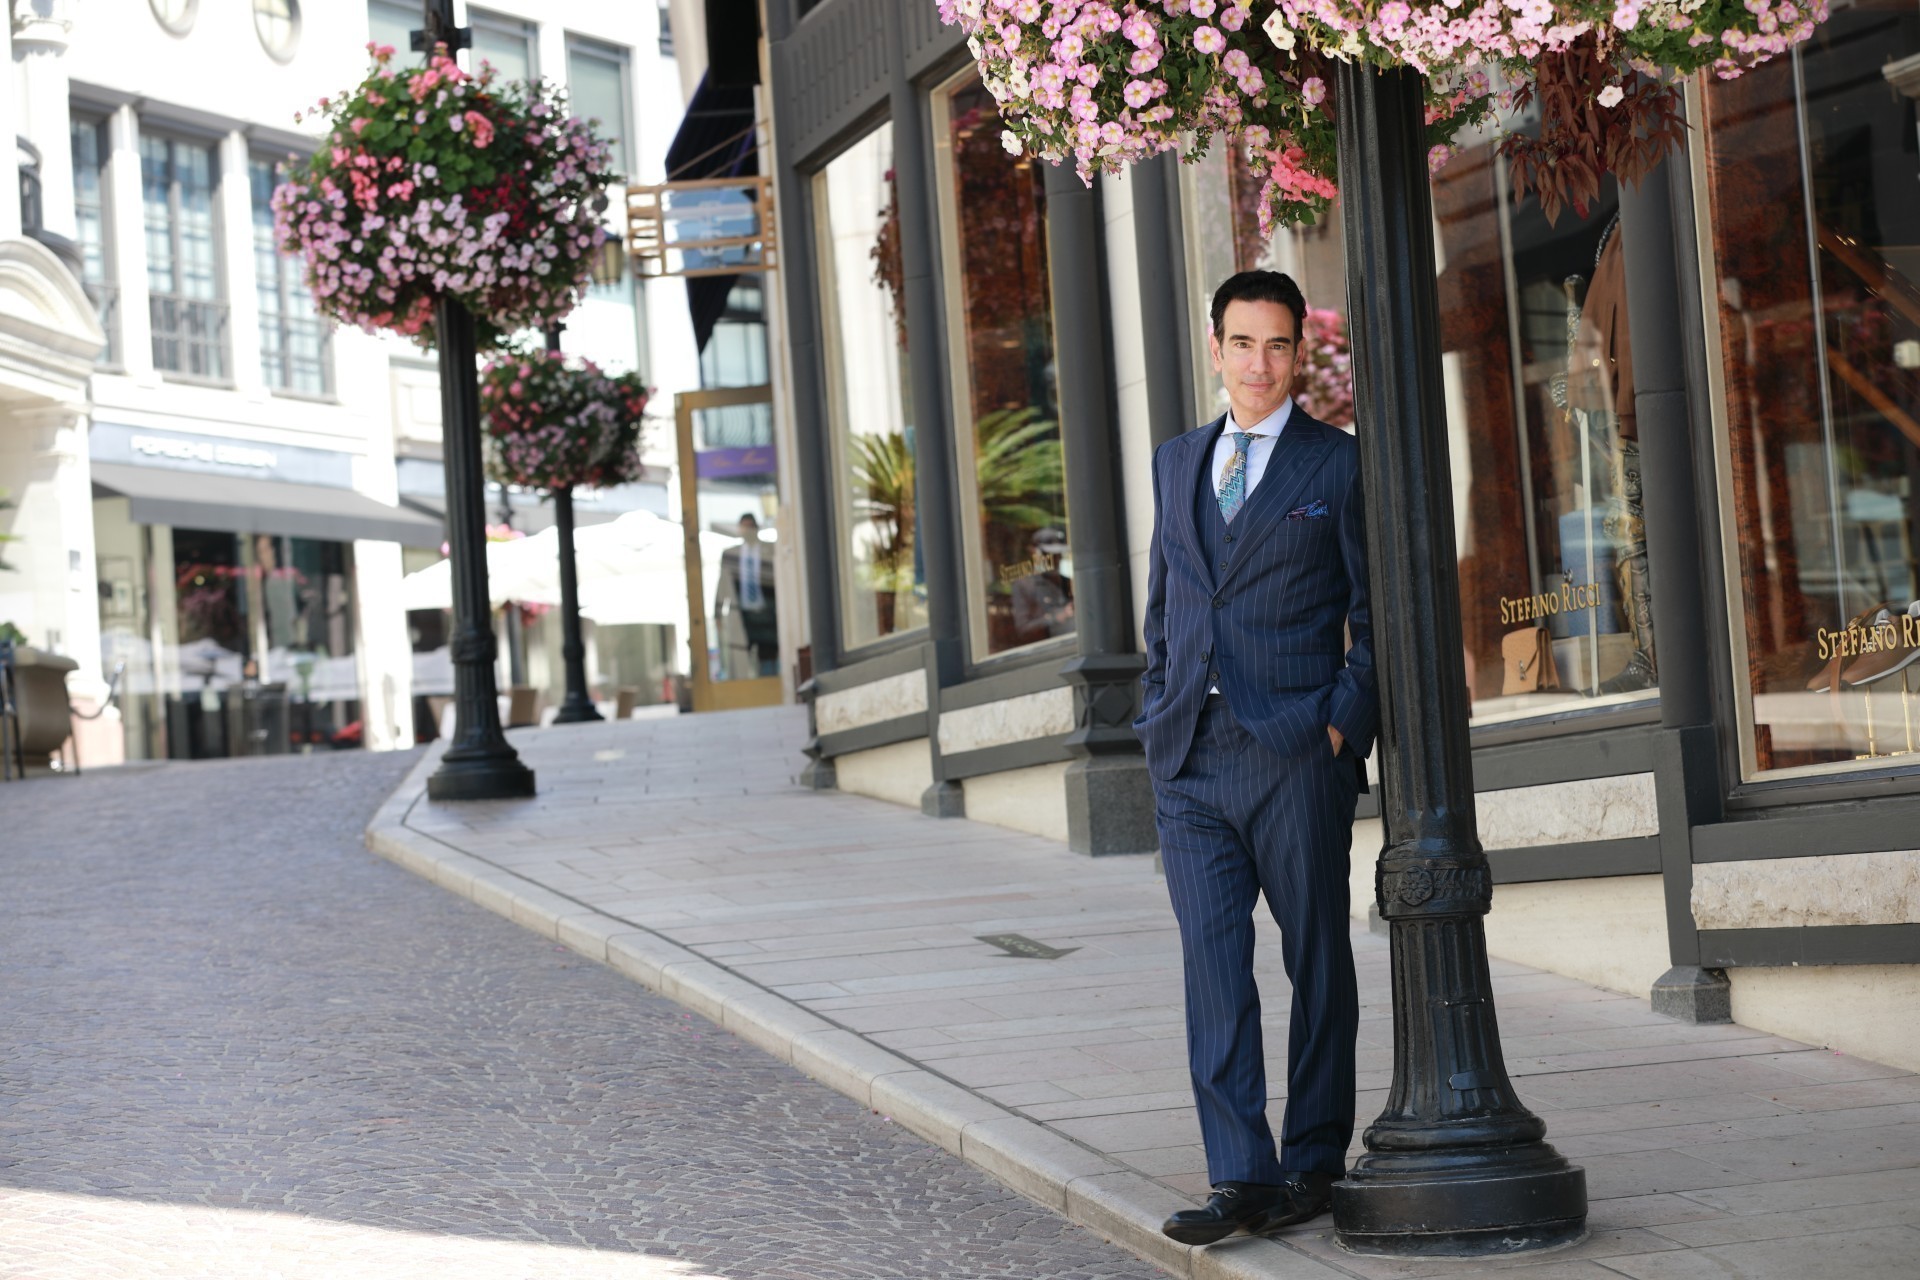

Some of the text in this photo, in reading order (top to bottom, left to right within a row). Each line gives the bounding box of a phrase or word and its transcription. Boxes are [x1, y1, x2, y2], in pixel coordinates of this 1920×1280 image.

[1500, 582, 1601, 625] STEFANO RICCI
[1817, 624, 1897, 660] STEFANO
